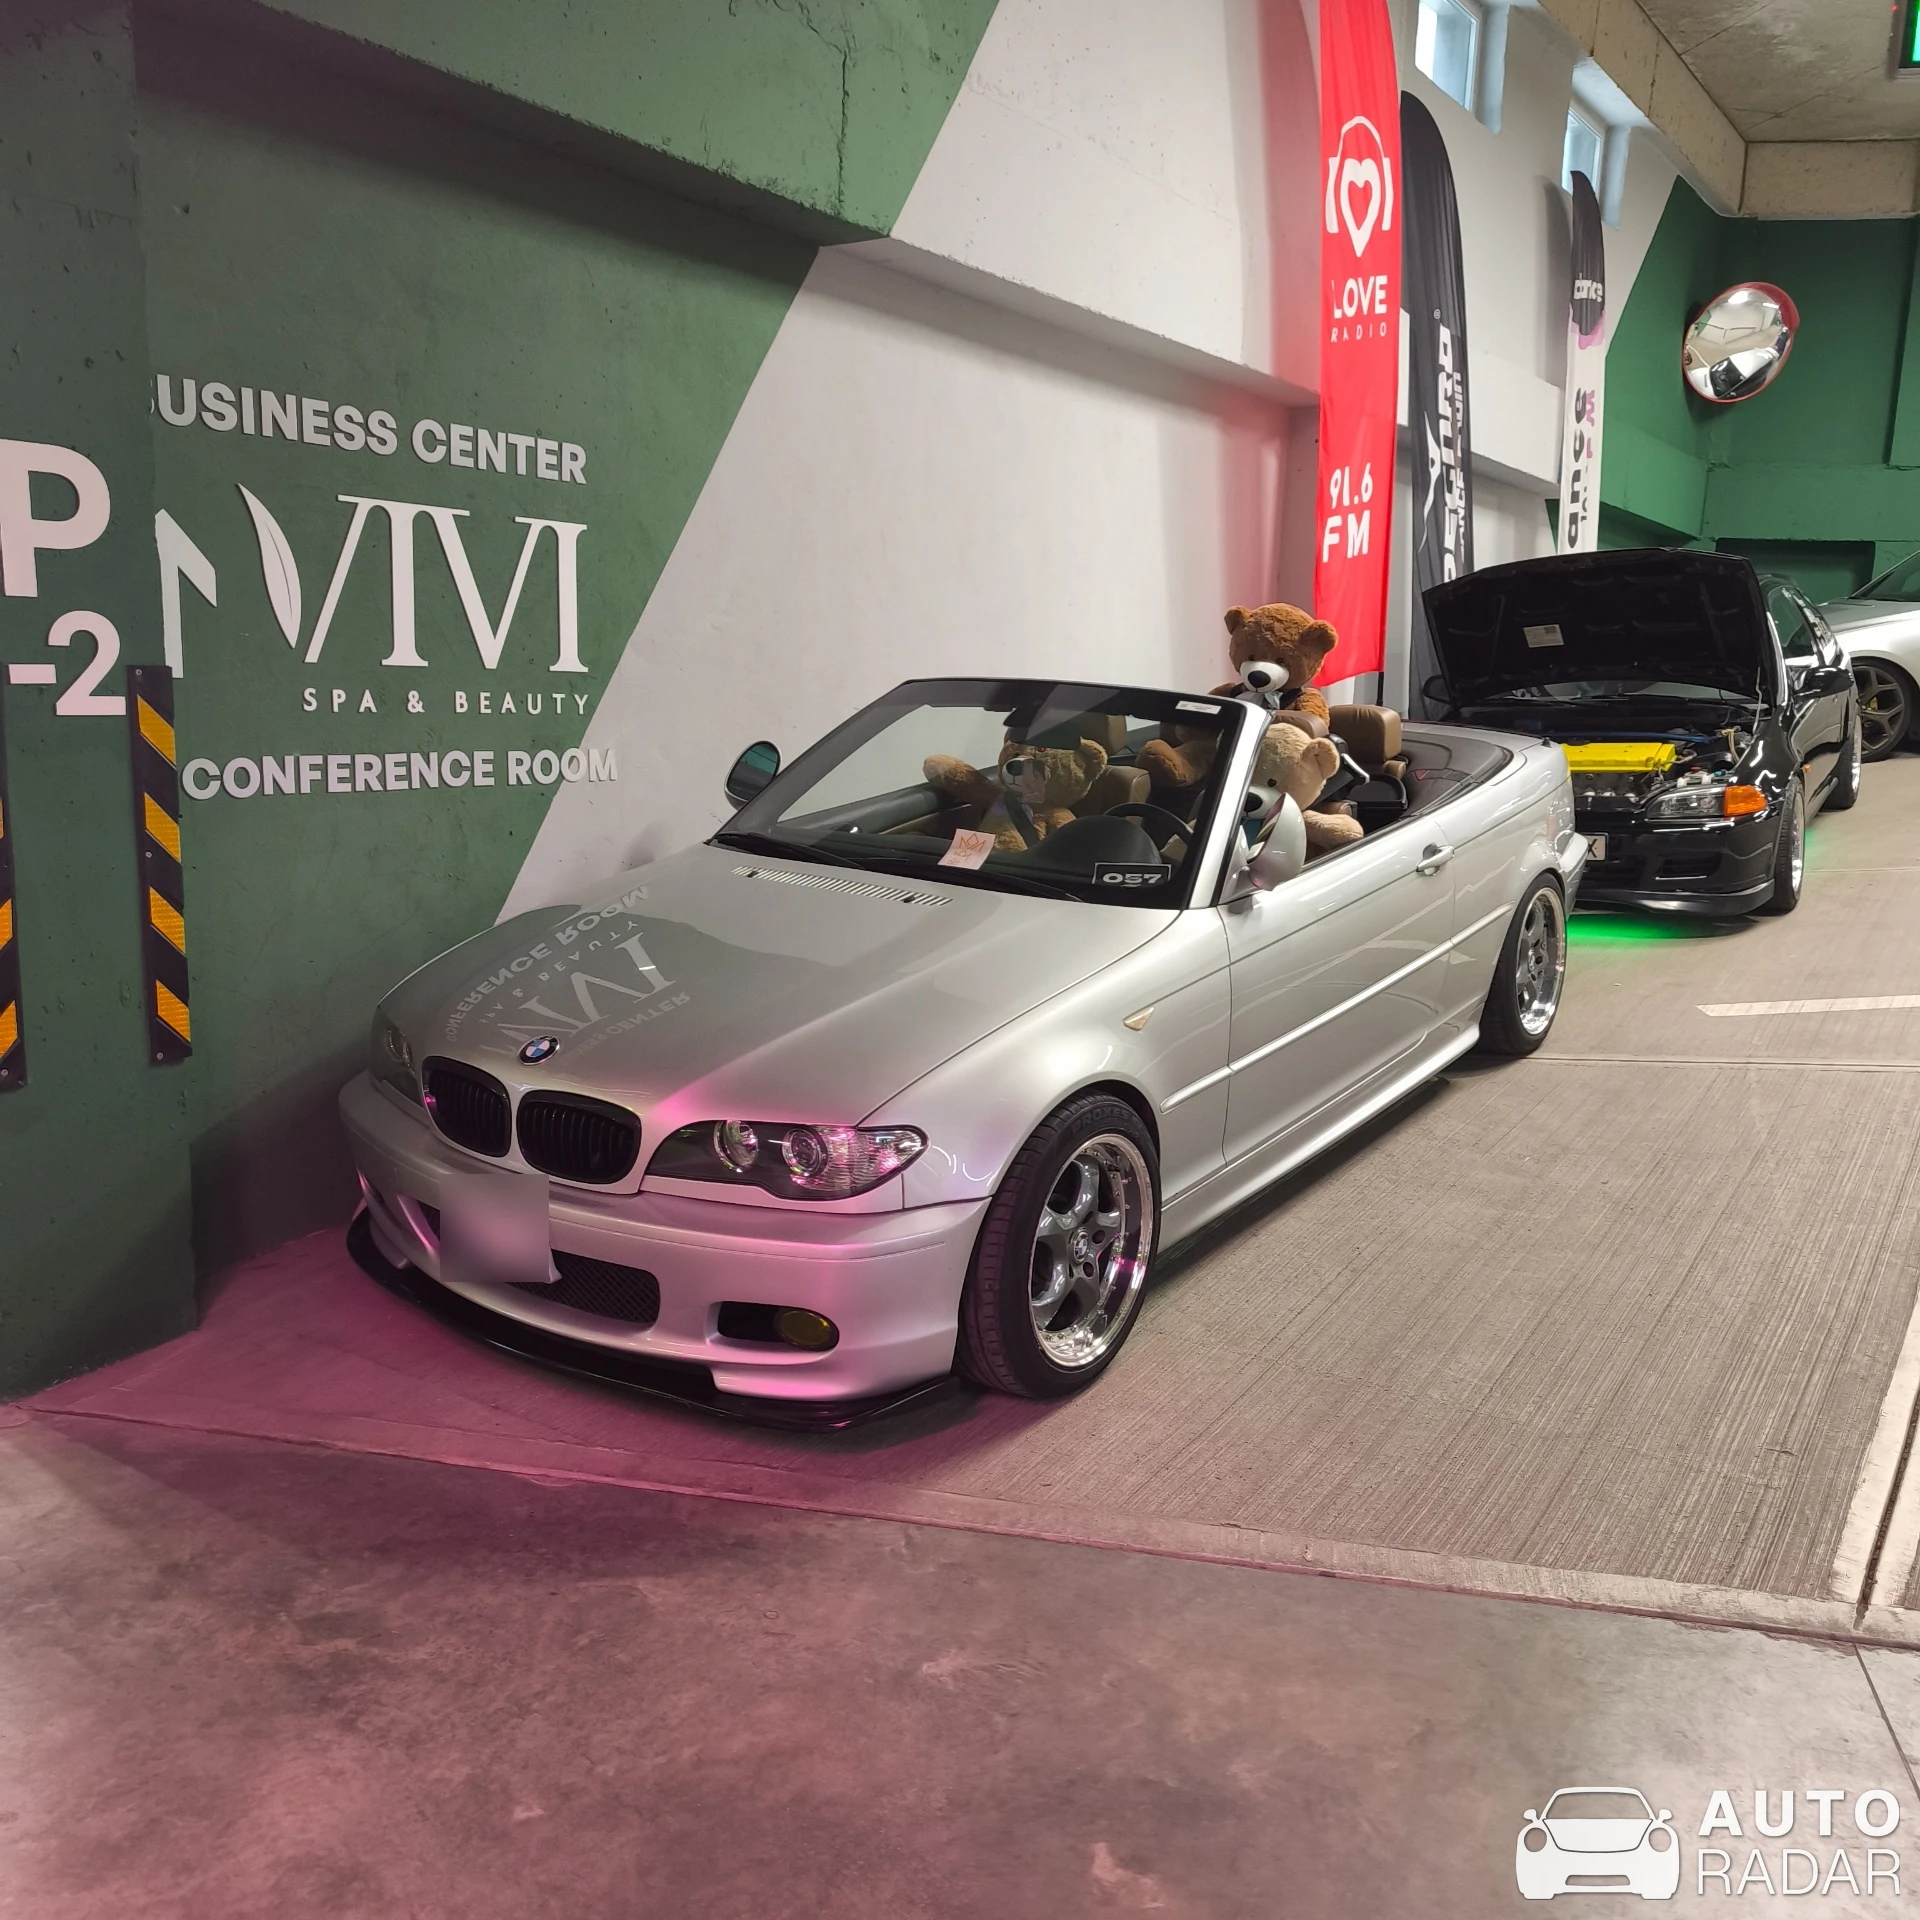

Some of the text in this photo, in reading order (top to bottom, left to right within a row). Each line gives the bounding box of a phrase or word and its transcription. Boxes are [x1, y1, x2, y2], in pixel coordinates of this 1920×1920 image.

[1331, 275, 1388, 319] LOVE
[1330, 321, 1387, 343] RADIO
[151, 374, 587, 484] USINESS CENTER
[1330, 462, 1373, 510] 91.6
[0, 438, 111, 598] P
[1322, 509, 1371, 563] FM
[8, 610, 126, 716] -2
[303, 688, 591, 715] SPA & BEAUTY
[181, 748, 618, 799] CONFERENCE ROOM
